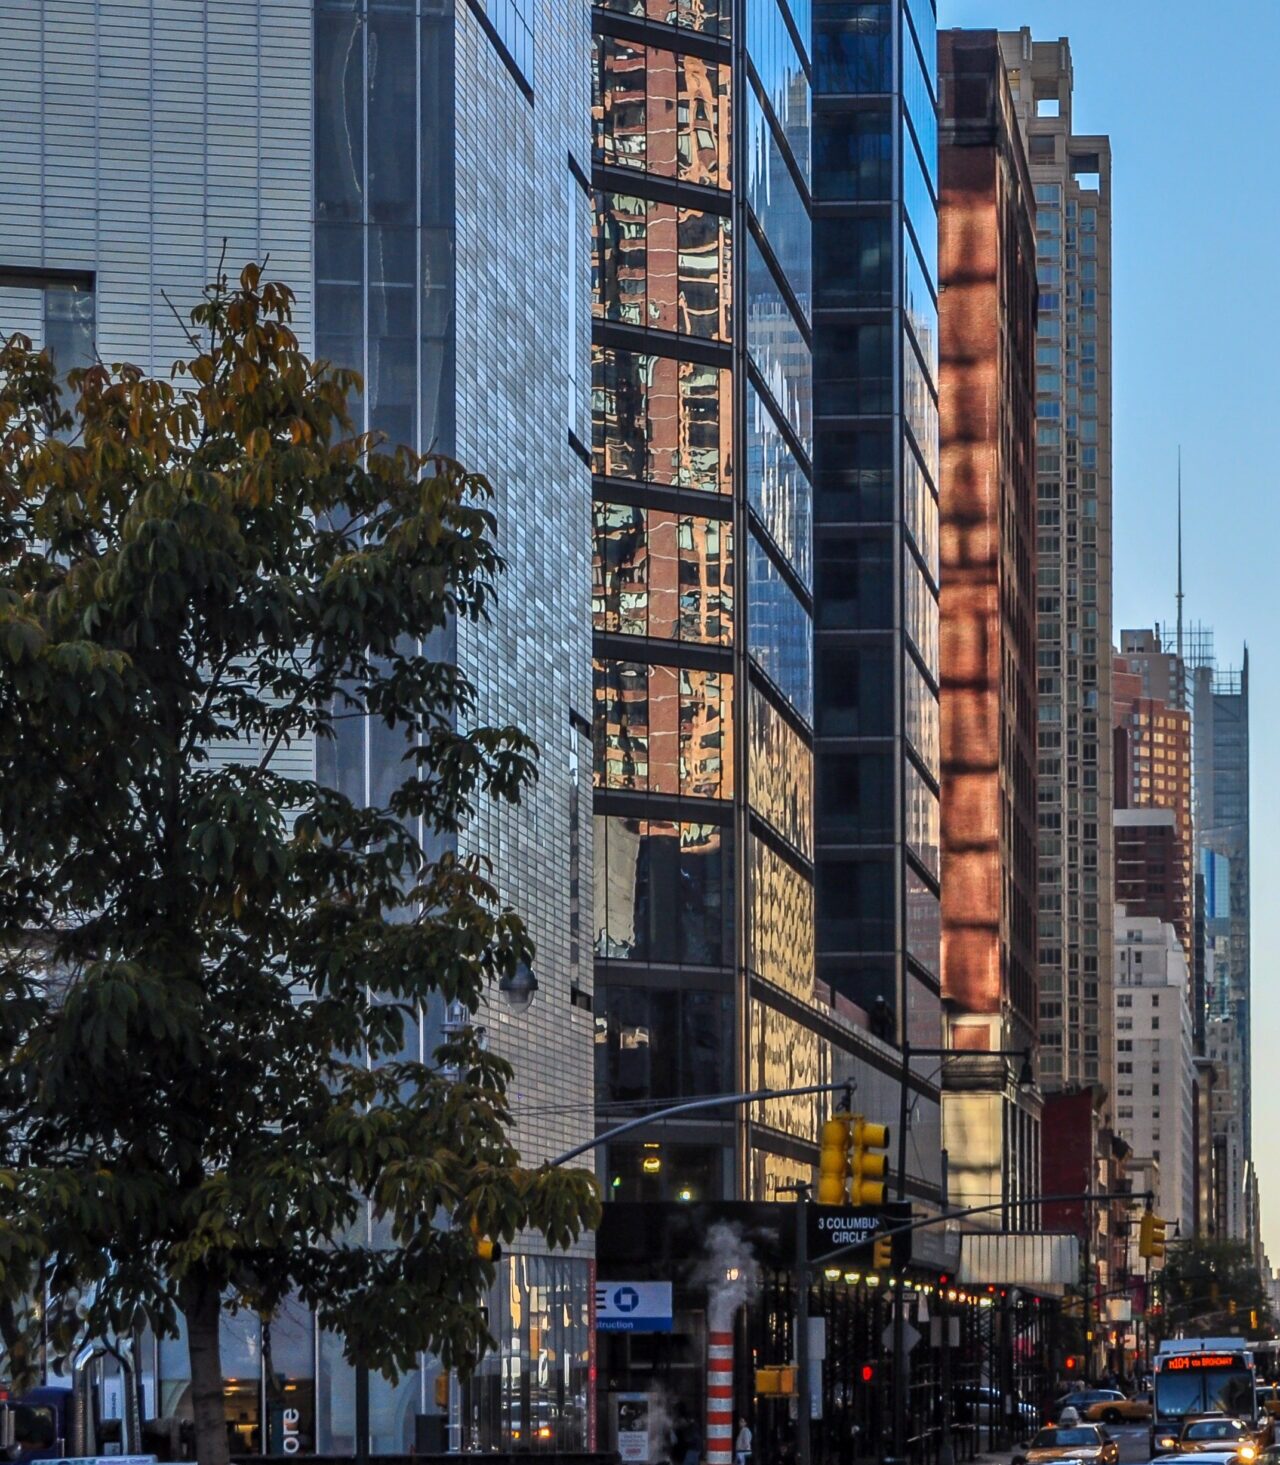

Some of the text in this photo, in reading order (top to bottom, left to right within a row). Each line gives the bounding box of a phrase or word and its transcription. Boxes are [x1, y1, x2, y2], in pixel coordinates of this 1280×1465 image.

[818, 1217, 825, 1229] 3
[832, 1231, 867, 1243] CIRCLE
[1168, 1357, 1190, 1370] M104
[1201, 1357, 1233, 1367] BROADWAY
